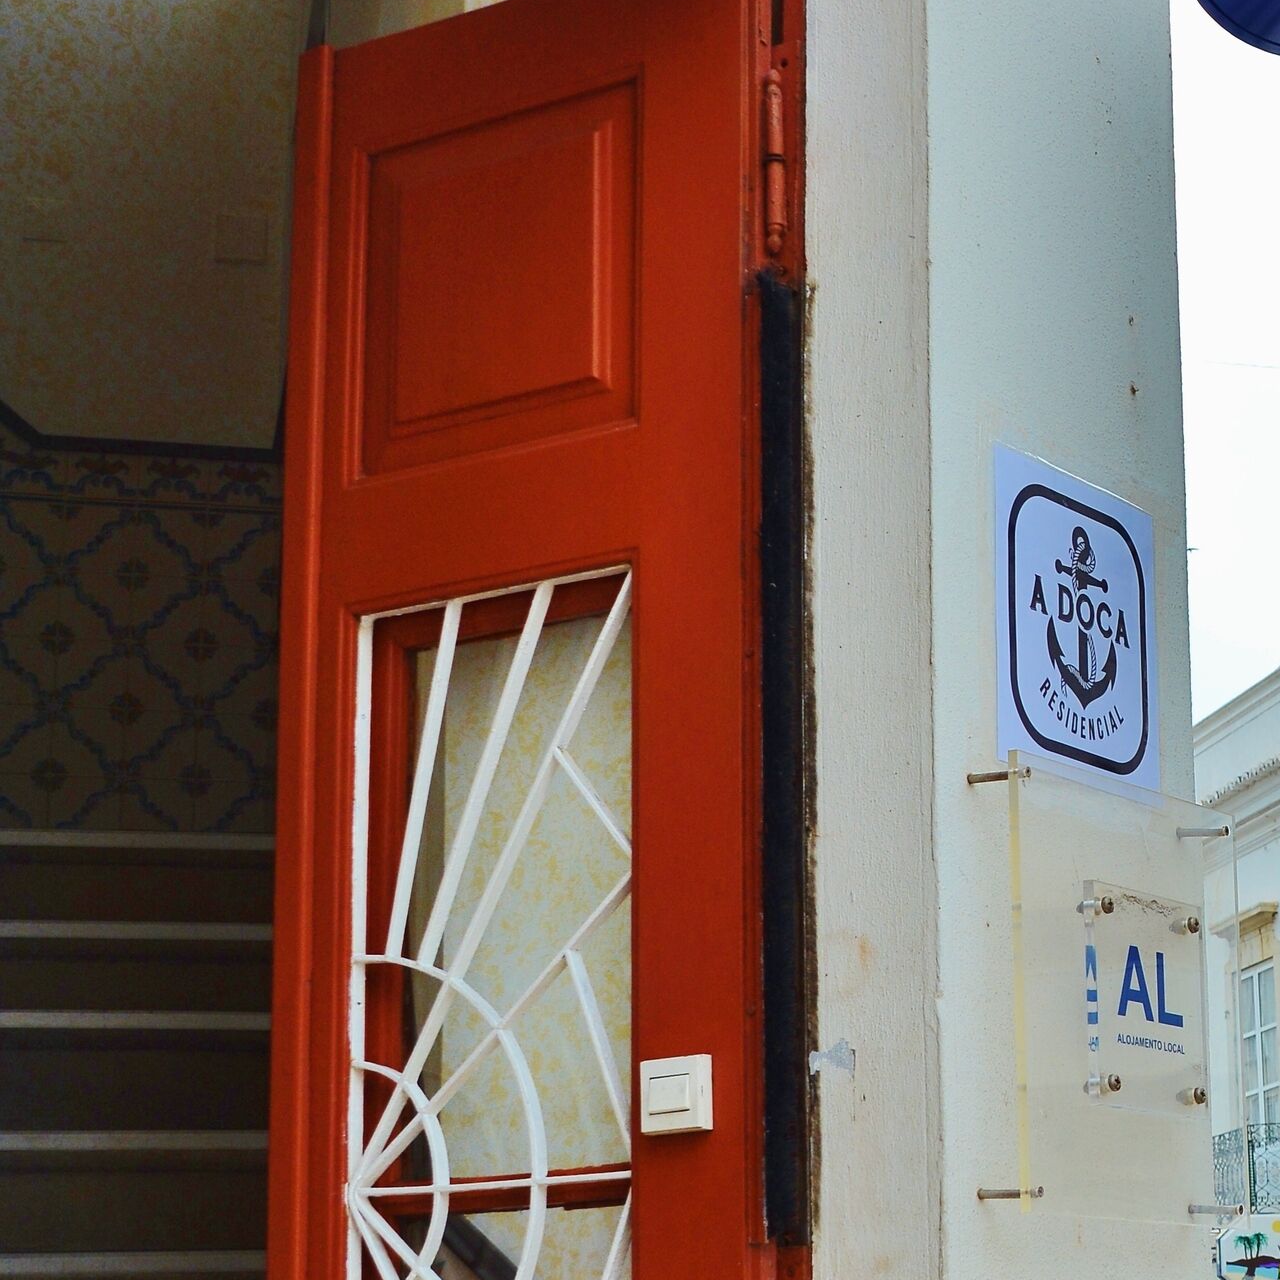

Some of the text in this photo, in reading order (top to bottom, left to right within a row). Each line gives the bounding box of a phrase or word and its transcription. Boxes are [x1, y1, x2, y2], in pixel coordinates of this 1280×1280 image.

[1029, 574, 1130, 649] A DOCA
[1040, 677, 1125, 741] RESIDENCIAL
[1117, 945, 1184, 1028] AL
[1117, 1033, 1185, 1055] ALOJAMENTO LOCAL
